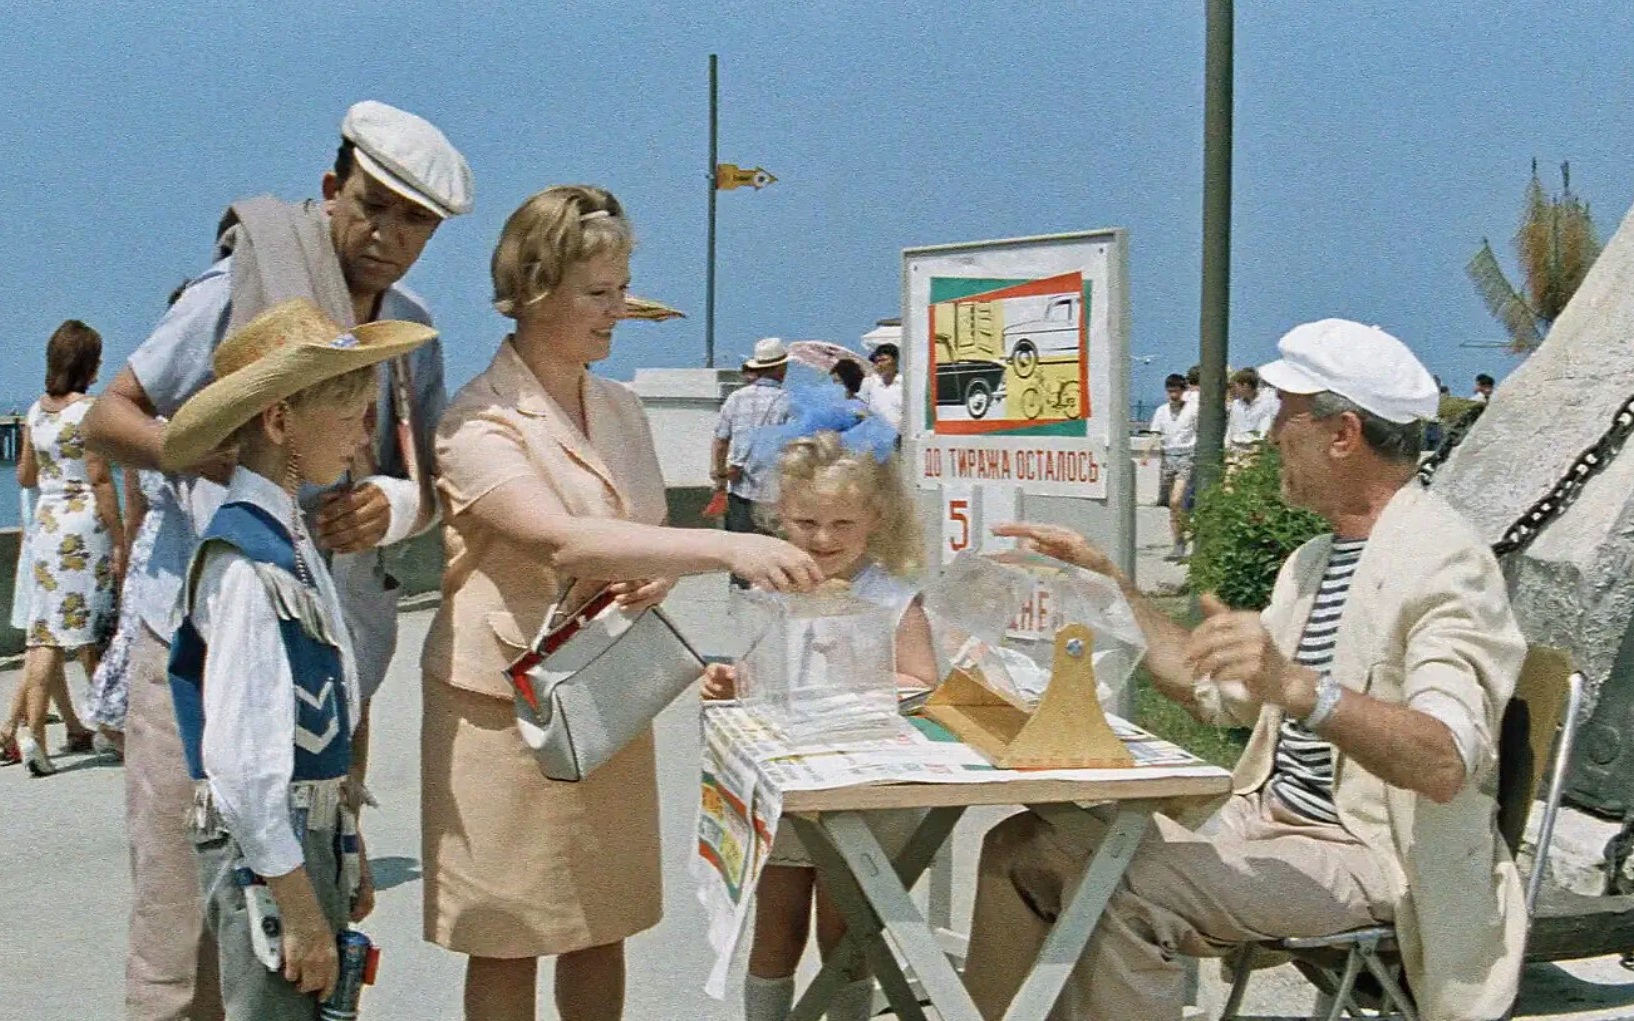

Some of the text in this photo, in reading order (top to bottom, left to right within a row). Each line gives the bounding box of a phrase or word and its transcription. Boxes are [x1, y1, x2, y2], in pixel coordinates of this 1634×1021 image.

[925, 448, 1099, 482] ДО ТИРАЖА ОСТАЛОСЬ
[949, 500, 968, 551] 5
